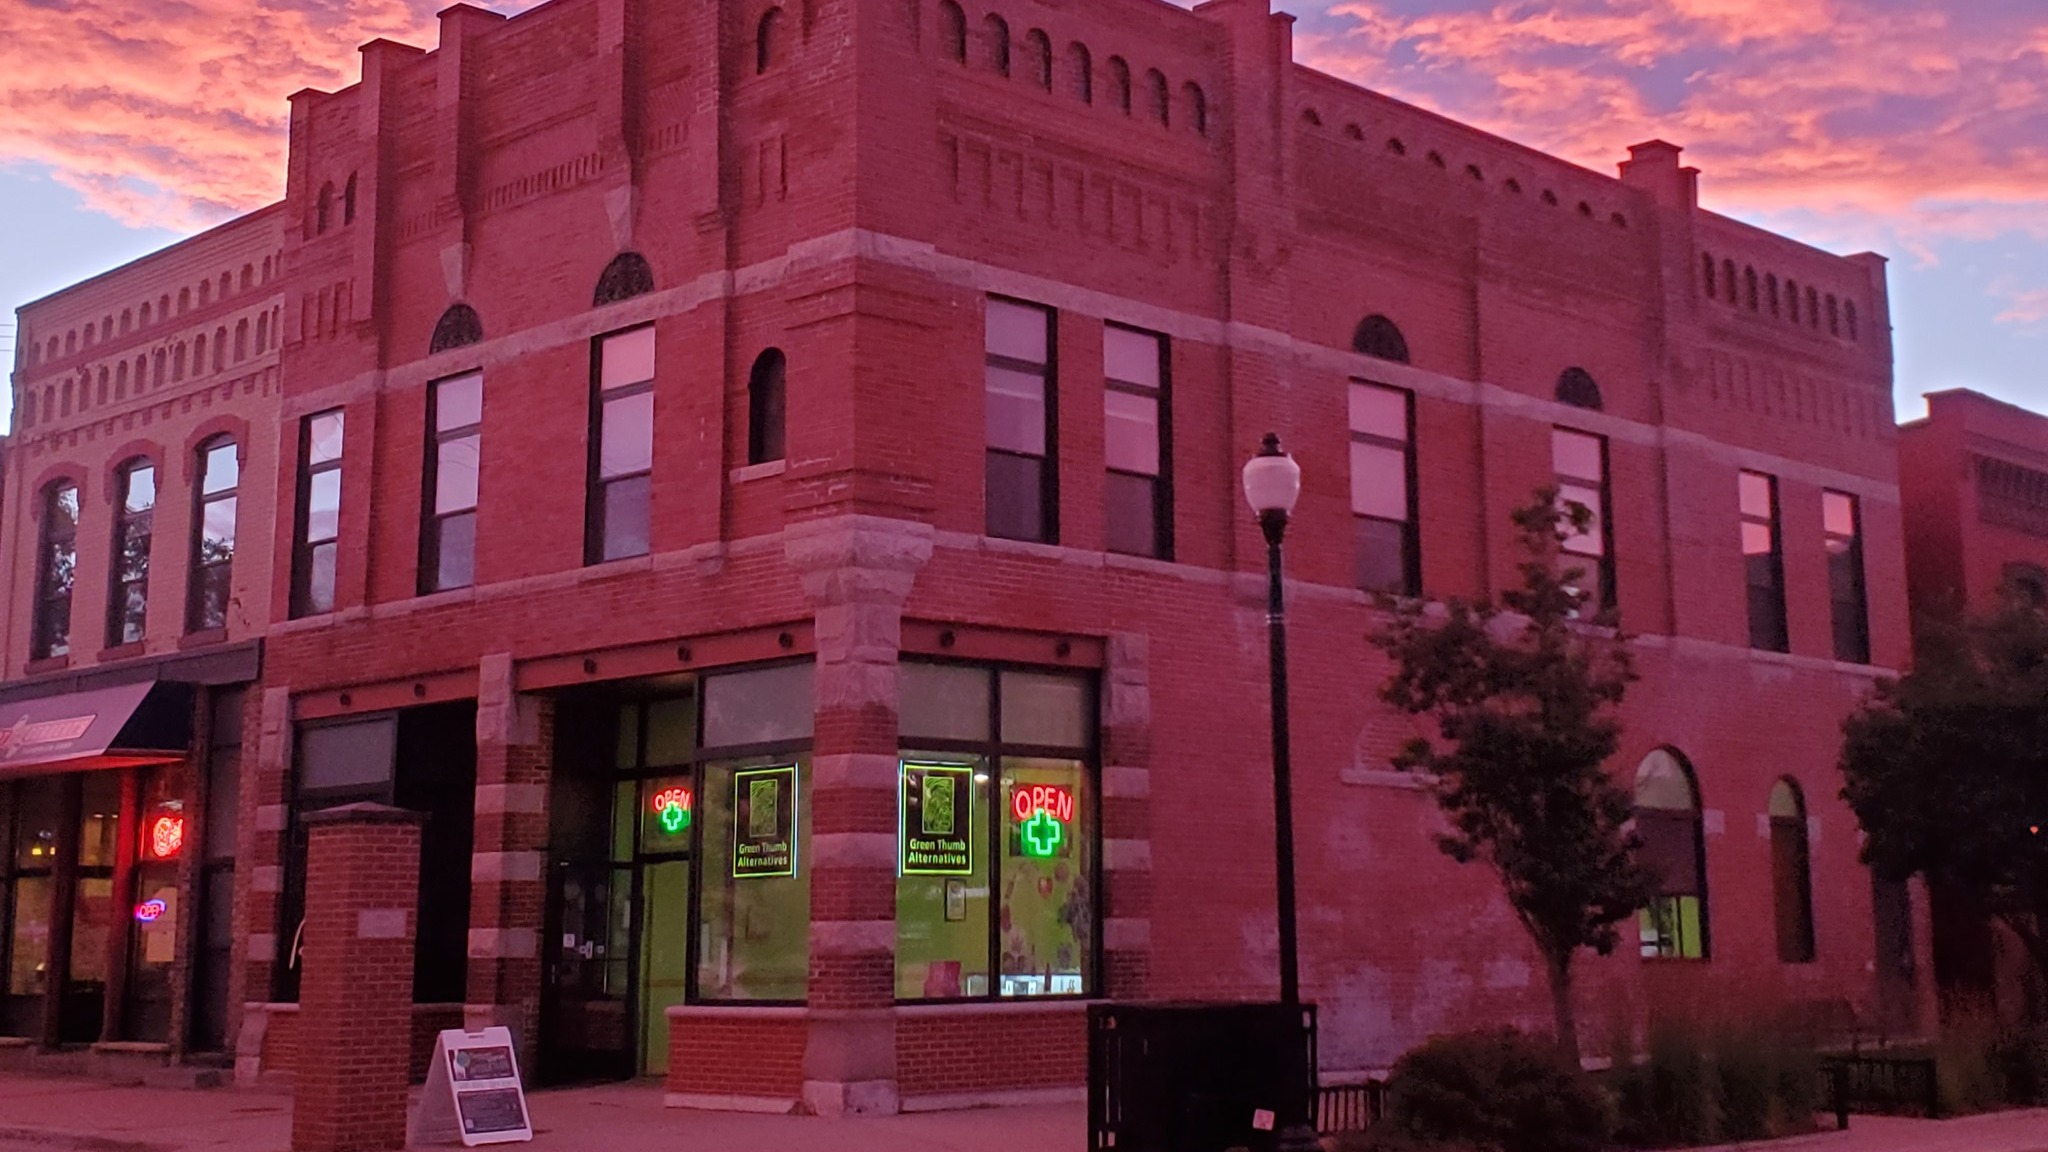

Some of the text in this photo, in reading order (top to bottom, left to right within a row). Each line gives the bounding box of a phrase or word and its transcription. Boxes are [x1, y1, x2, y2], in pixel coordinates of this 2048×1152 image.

[654, 788, 691, 811] OPEN
[1015, 786, 1072, 821] OPEN
[739, 840, 787, 854] Green Thumb
[909, 838, 966, 851] Green Thumb
[738, 856, 788, 867] Alternatives
[908, 851, 966, 865] Alternatives
